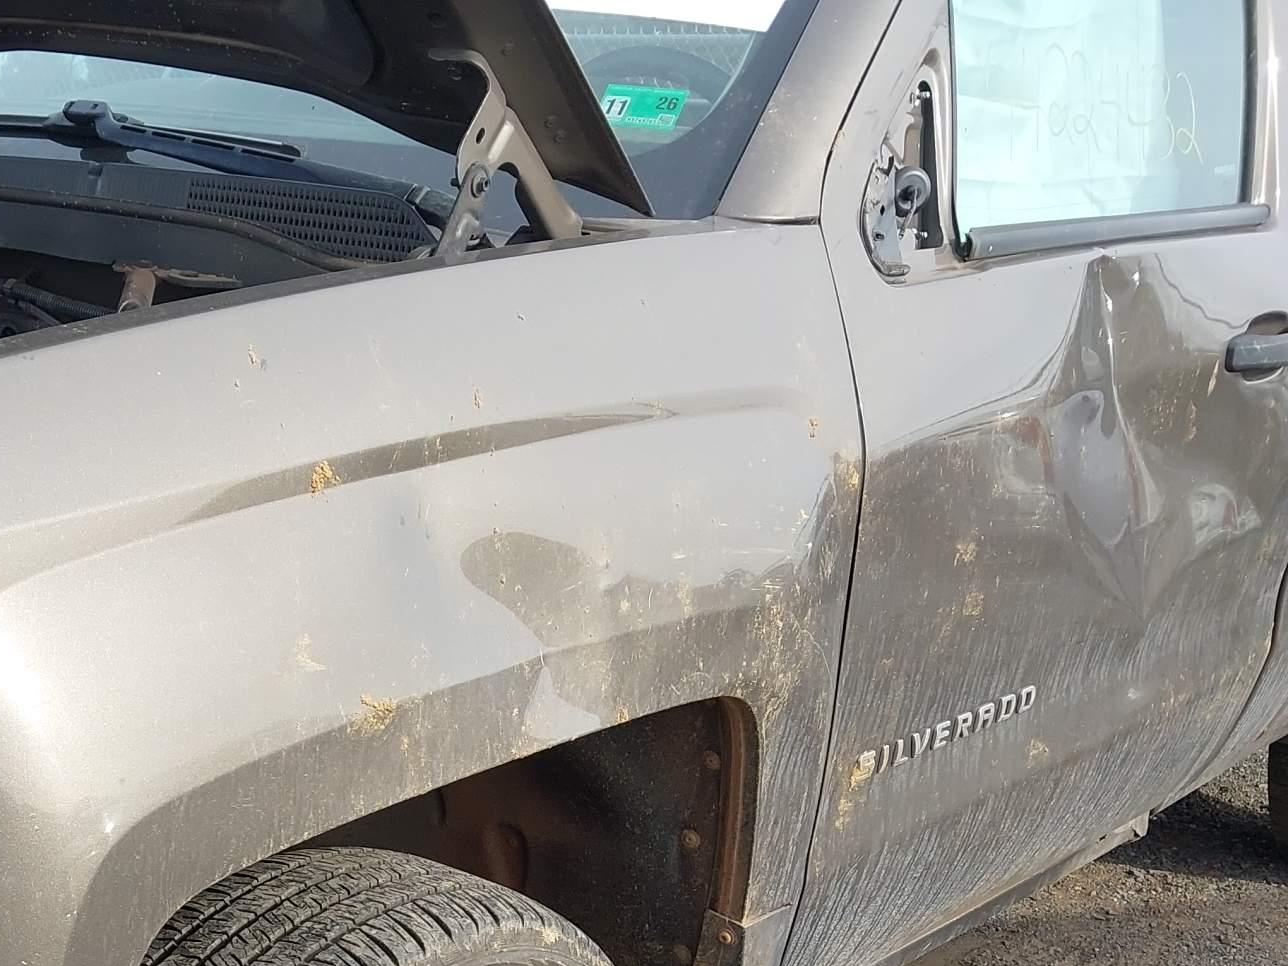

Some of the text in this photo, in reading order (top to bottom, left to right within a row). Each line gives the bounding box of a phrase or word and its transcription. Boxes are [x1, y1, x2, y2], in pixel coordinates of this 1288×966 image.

[604, 96, 680, 116] 11 26
[853, 684, 1038, 783] SILVERADO
